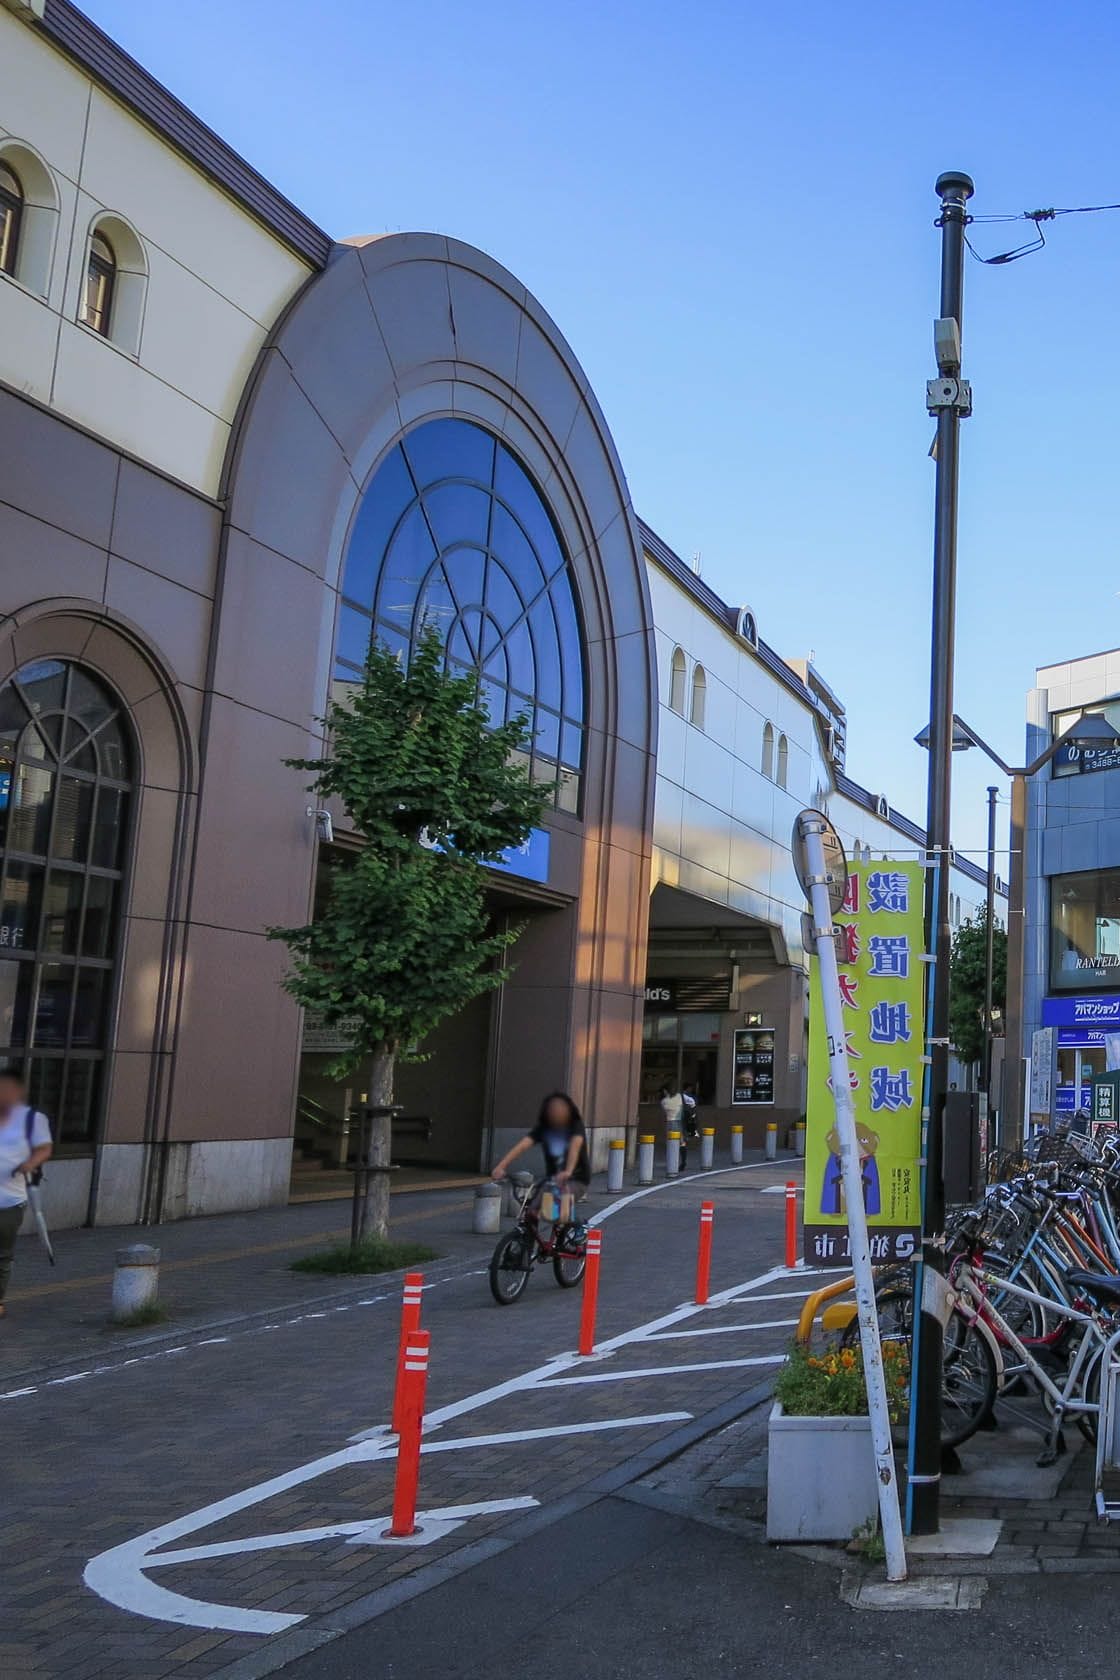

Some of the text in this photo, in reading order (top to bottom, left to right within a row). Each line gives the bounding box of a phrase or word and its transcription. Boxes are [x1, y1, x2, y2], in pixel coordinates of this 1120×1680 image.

[1075, 1001, 1120, 1016] アパマンショップ
[1087, 1031, 1105, 1040] アパマン
